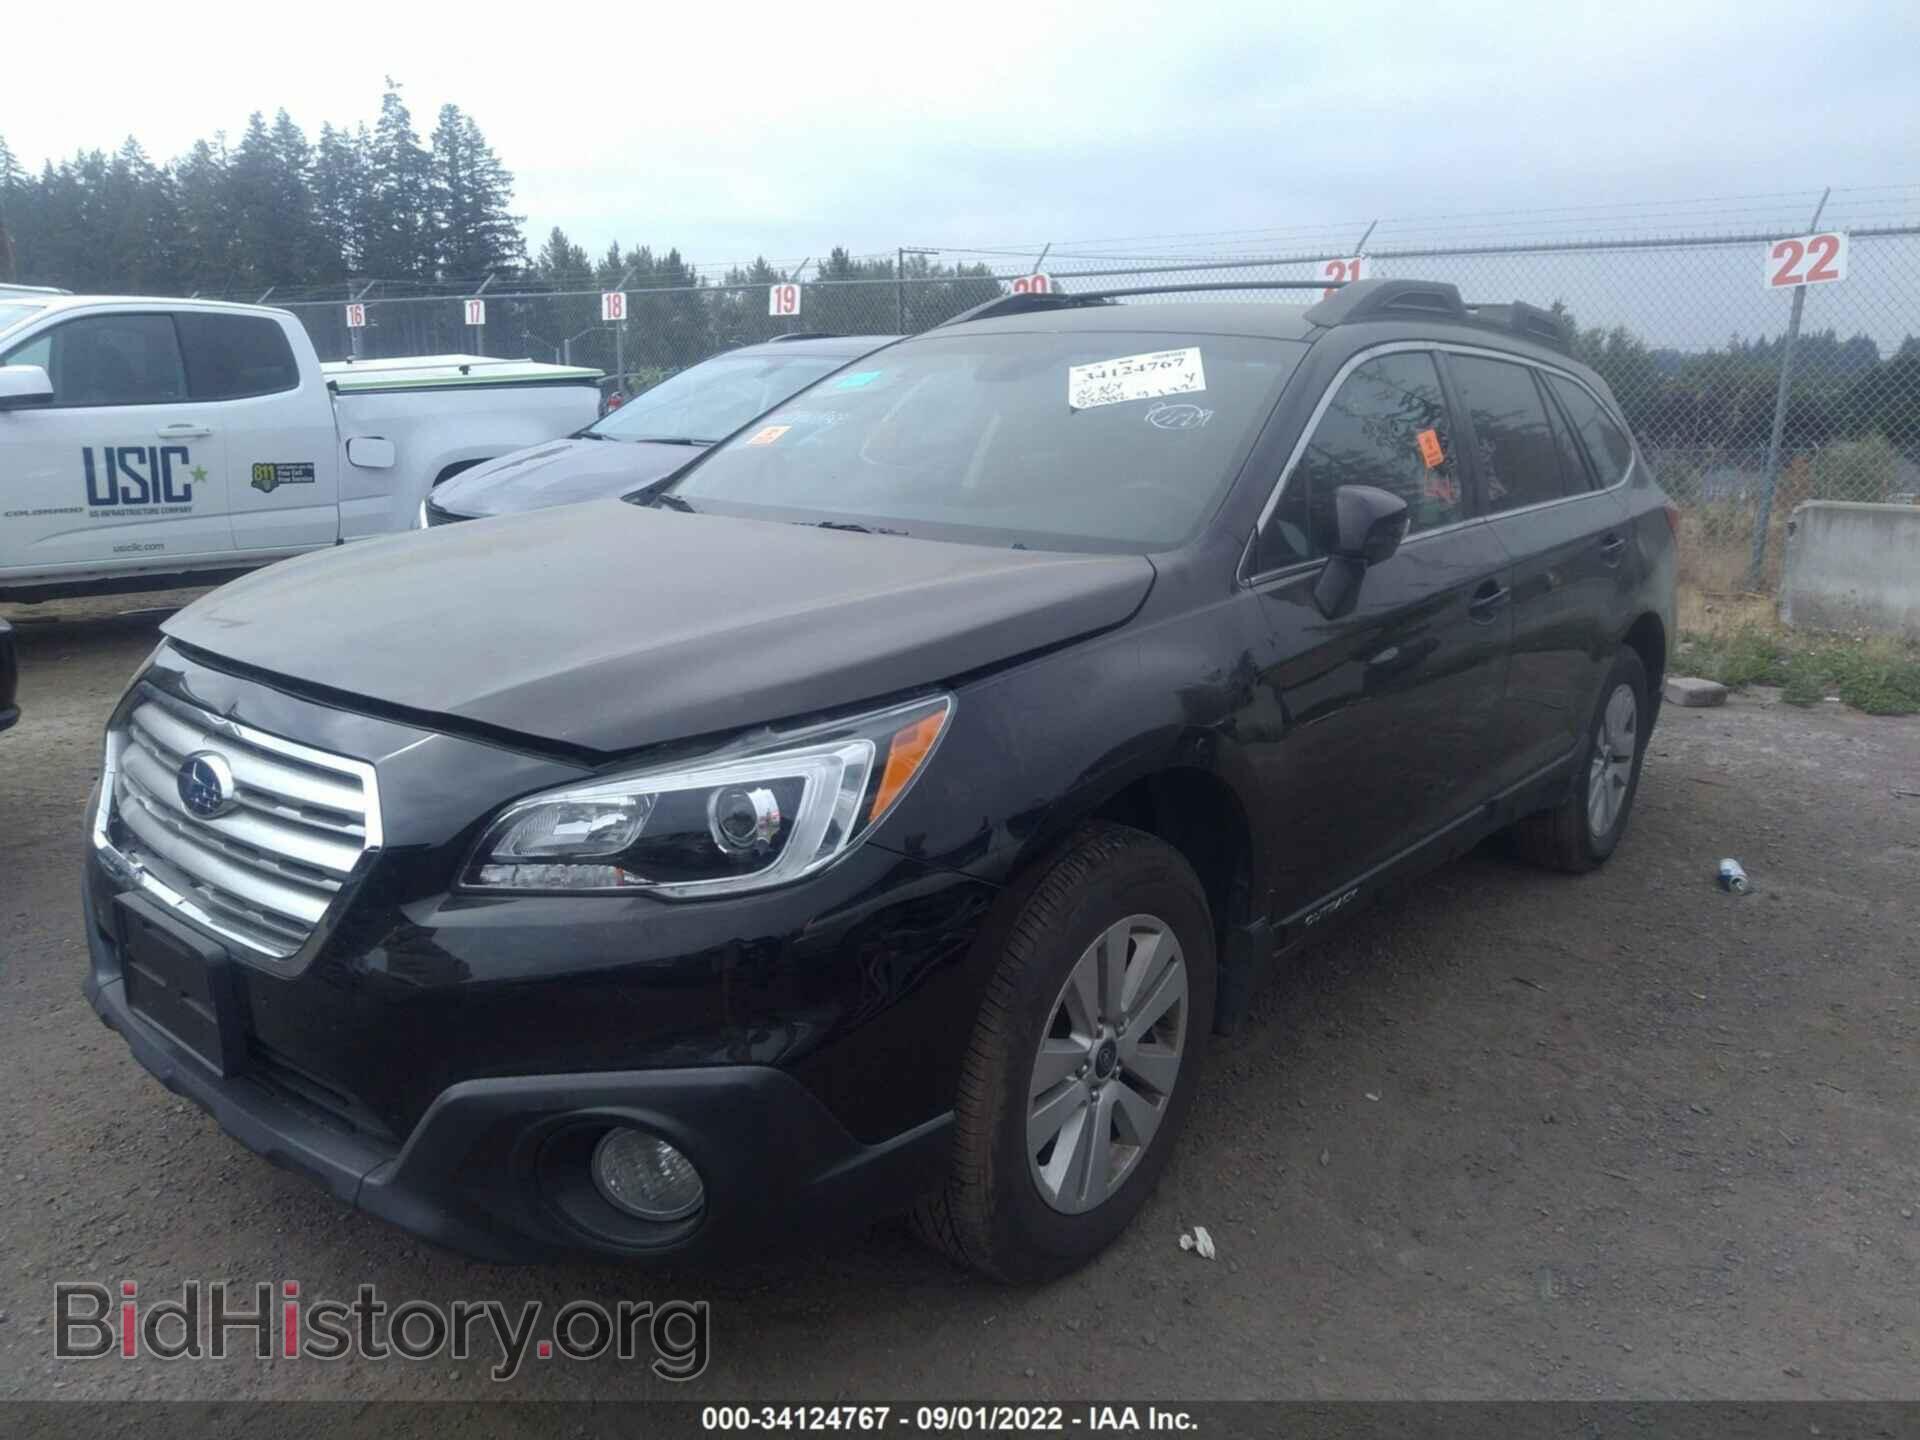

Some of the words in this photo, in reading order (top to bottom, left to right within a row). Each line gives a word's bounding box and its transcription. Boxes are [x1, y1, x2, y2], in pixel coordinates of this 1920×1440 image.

[1770, 234, 1840, 286] 22
[1323, 258, 1361, 299] 21
[468, 301, 482, 323] 17
[606, 294, 623, 319] 18
[774, 286, 796, 314] 19
[349, 305, 362, 325] 16
[82, 446, 193, 507] USIC
[254, 464, 275, 480] 811
